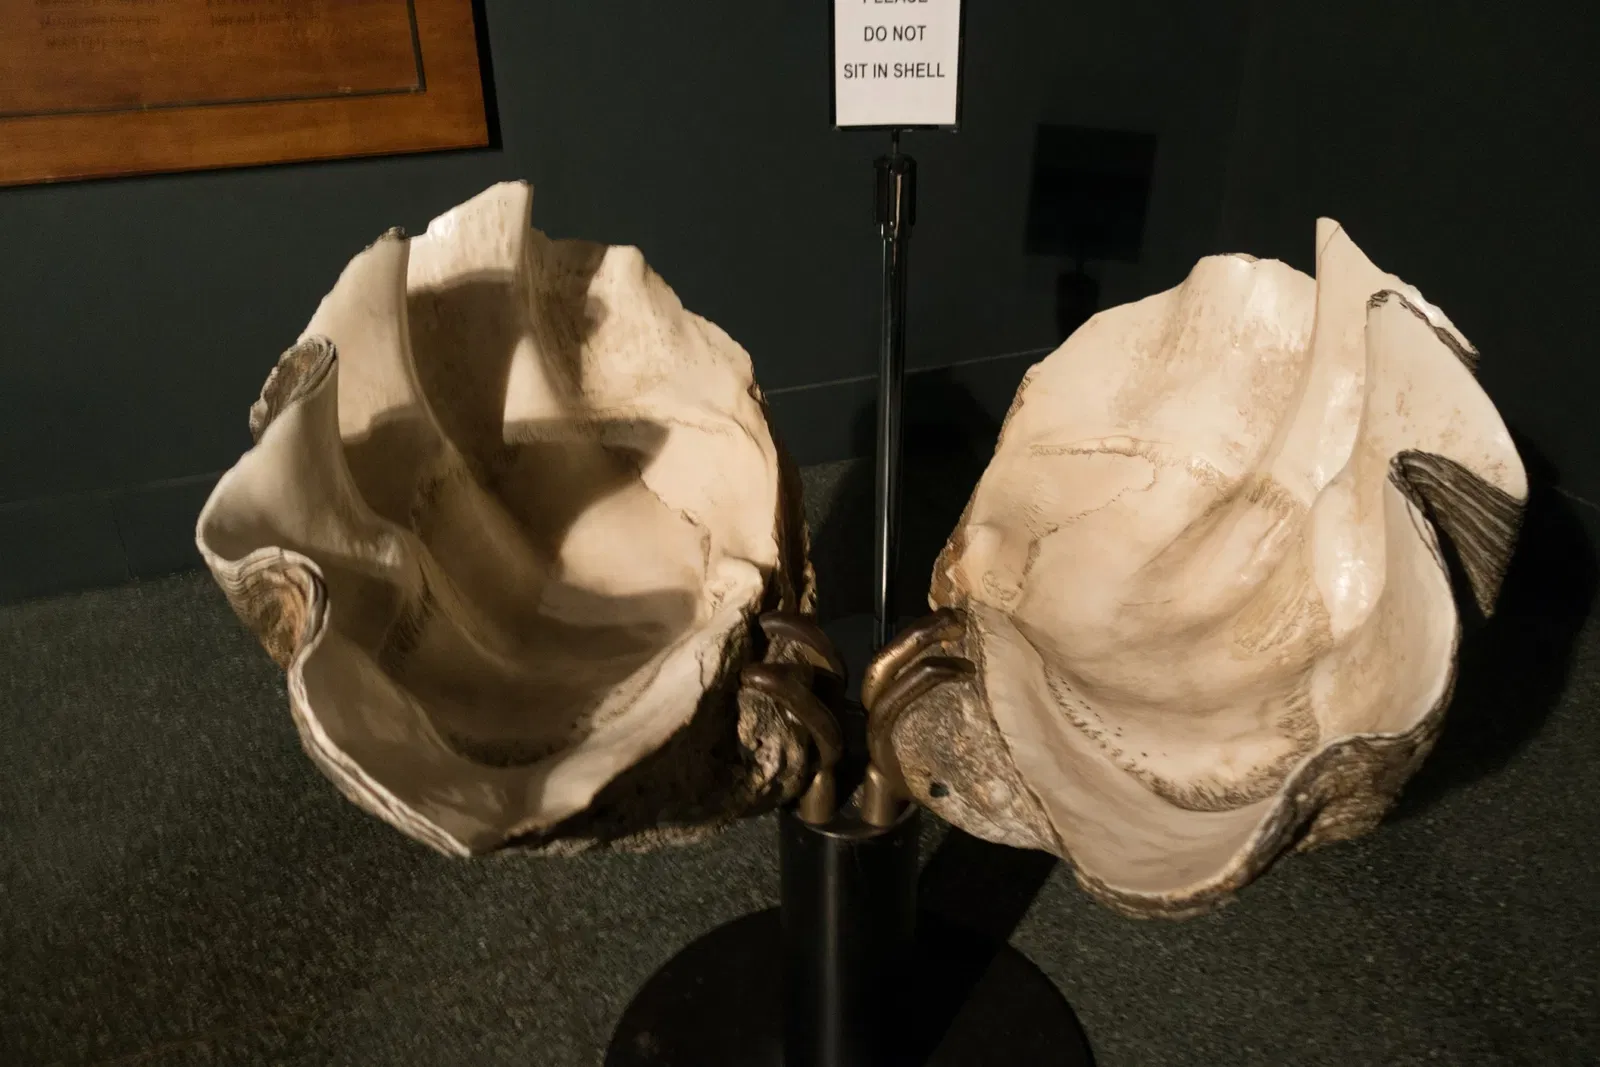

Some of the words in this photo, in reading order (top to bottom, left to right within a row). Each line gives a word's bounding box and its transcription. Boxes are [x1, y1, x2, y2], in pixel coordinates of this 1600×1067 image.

[864, 25, 888, 42] DO
[893, 25, 927, 42] NOT
[844, 62, 868, 79] SIT
[873, 62, 888, 79] IN
[893, 62, 945, 78] SHELL
